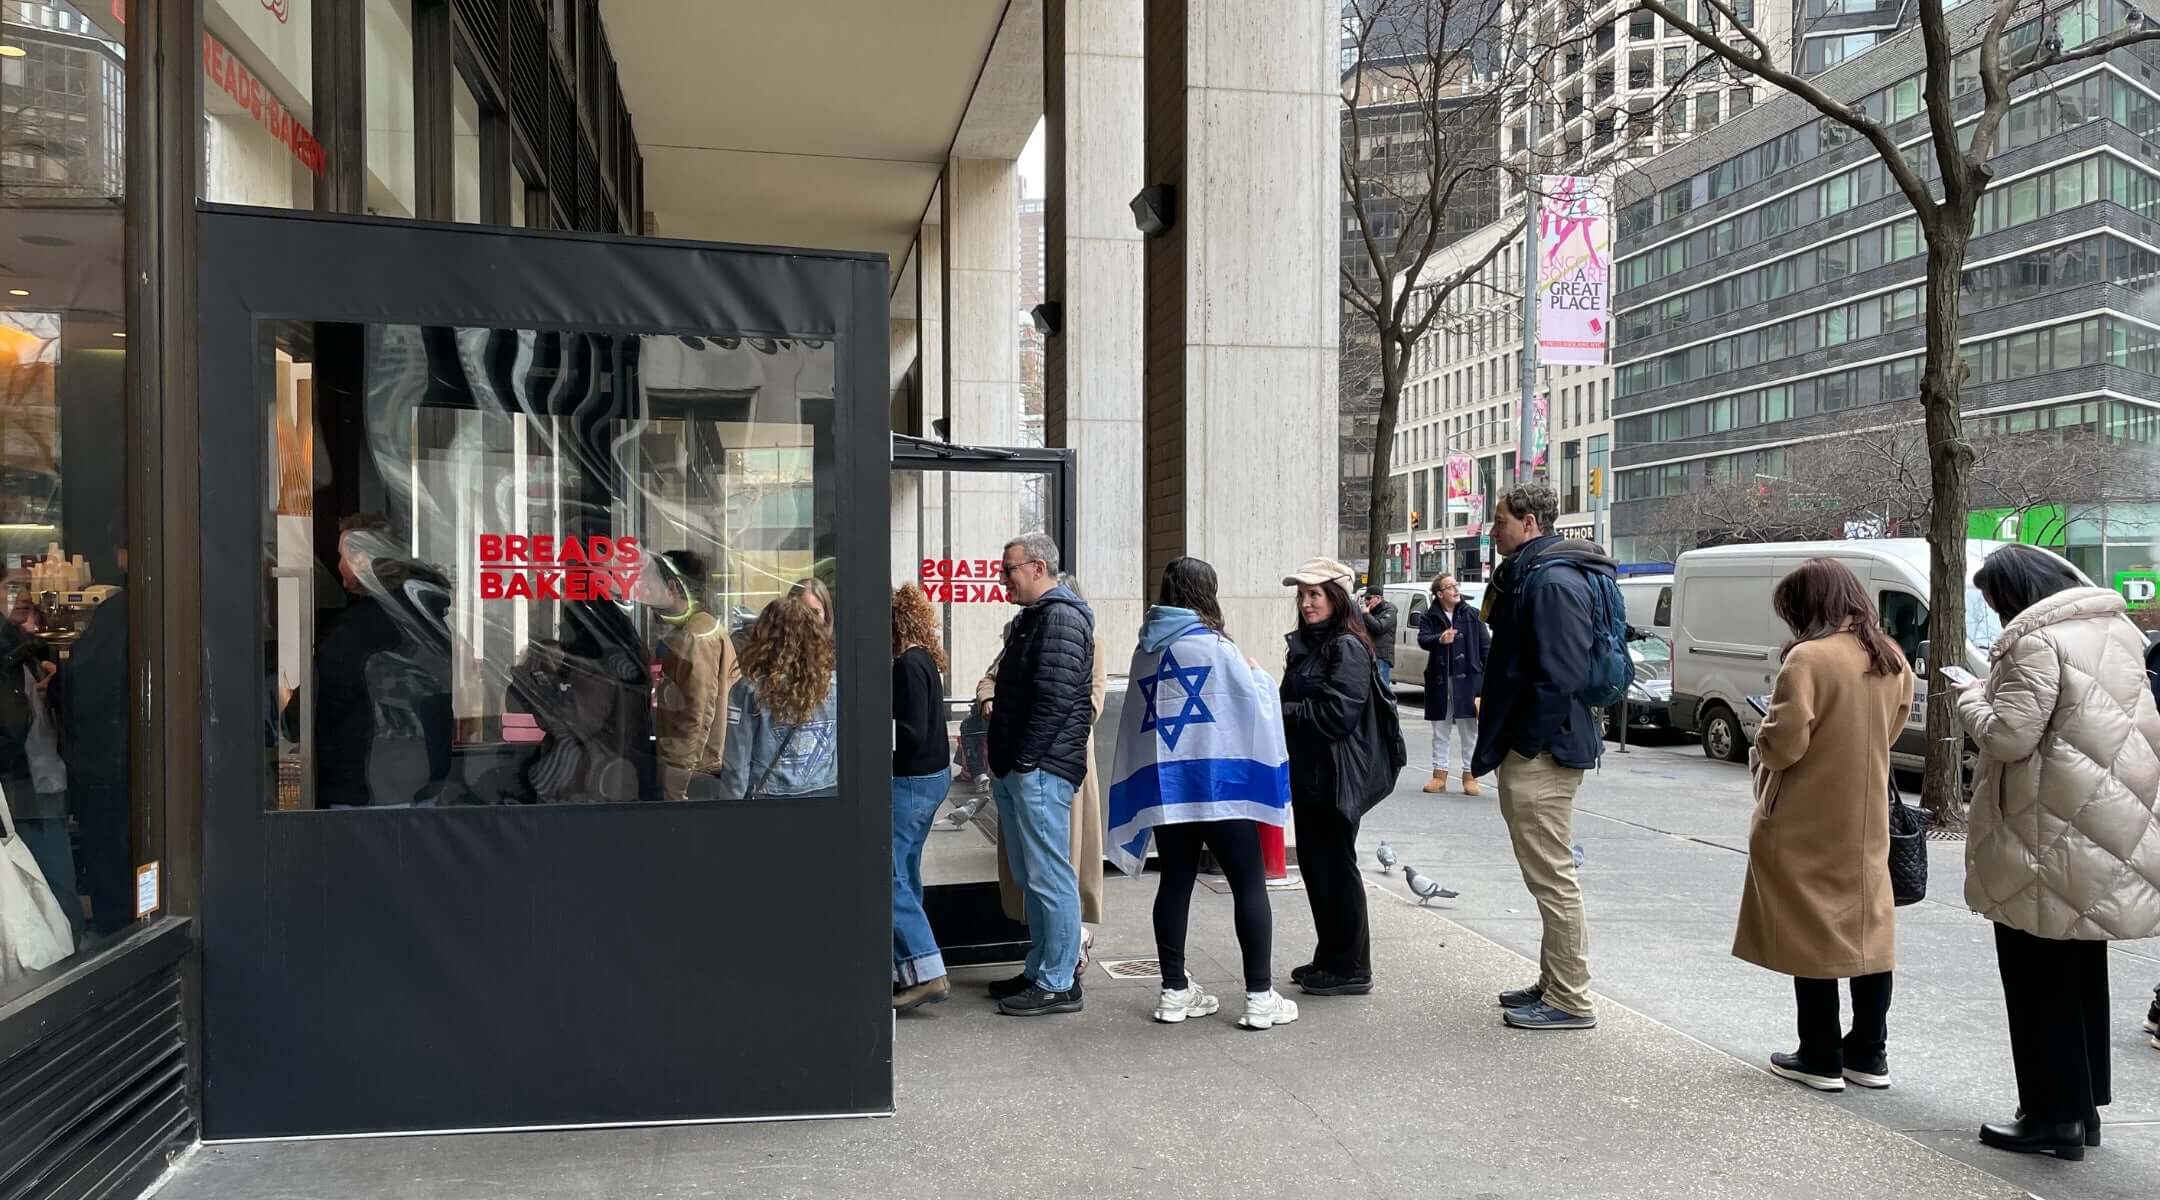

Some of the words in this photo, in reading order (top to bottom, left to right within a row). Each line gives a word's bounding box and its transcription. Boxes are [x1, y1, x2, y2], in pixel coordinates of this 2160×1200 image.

[203, 31, 263, 121] READS
[1542, 266, 1607, 282] SQURE
[1575, 268, 1587, 282] A
[1549, 282, 1602, 296] GREAT
[1550, 296, 1601, 310] PLACE
[1559, 526, 1594, 540] EPHOR
[479, 534, 642, 563] BREADS
[480, 572, 641, 600] BAKERY
[2122, 580, 2156, 601] TD
